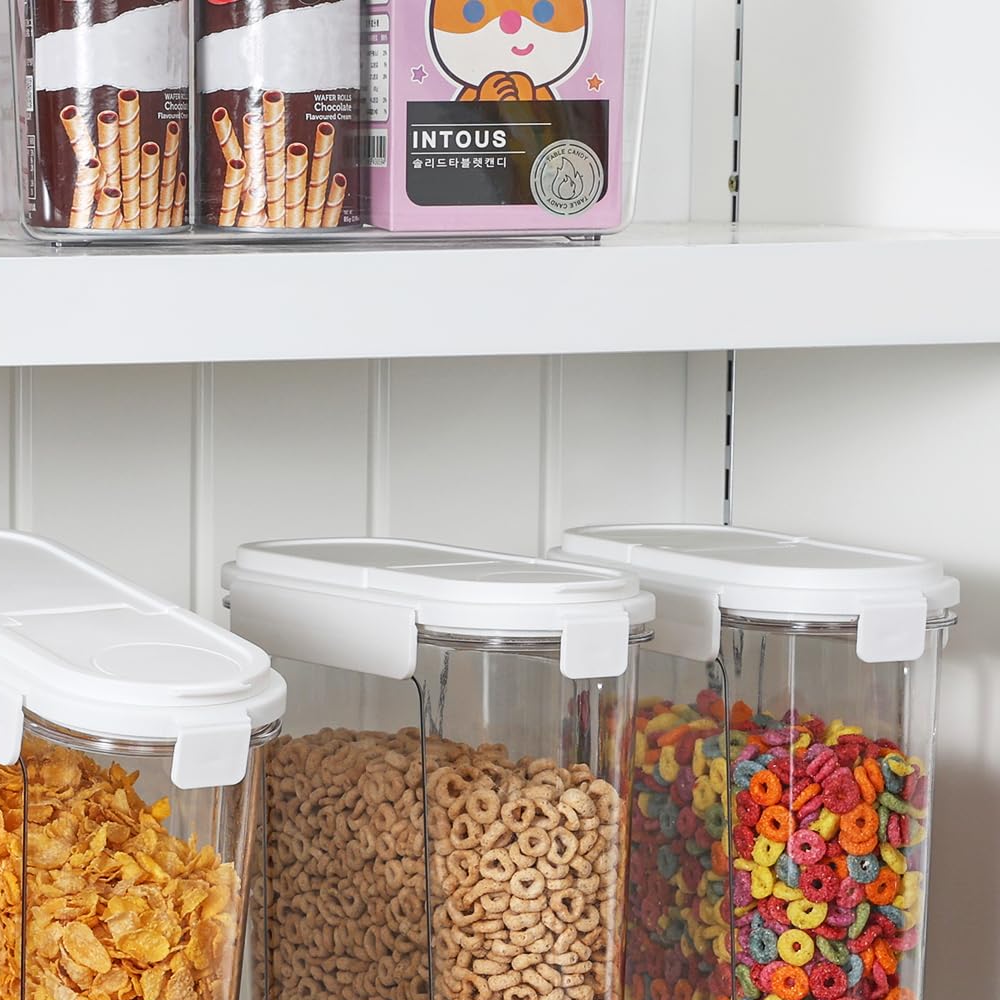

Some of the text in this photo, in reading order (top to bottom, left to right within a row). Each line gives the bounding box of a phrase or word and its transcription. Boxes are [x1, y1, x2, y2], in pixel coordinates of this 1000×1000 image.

[314, 102, 352, 111] Chocolate
[412, 130, 506, 148] INTOUS
[547, 148, 588, 162] TABLE CANDY
[548, 196, 588, 209] TABLE CANDY
